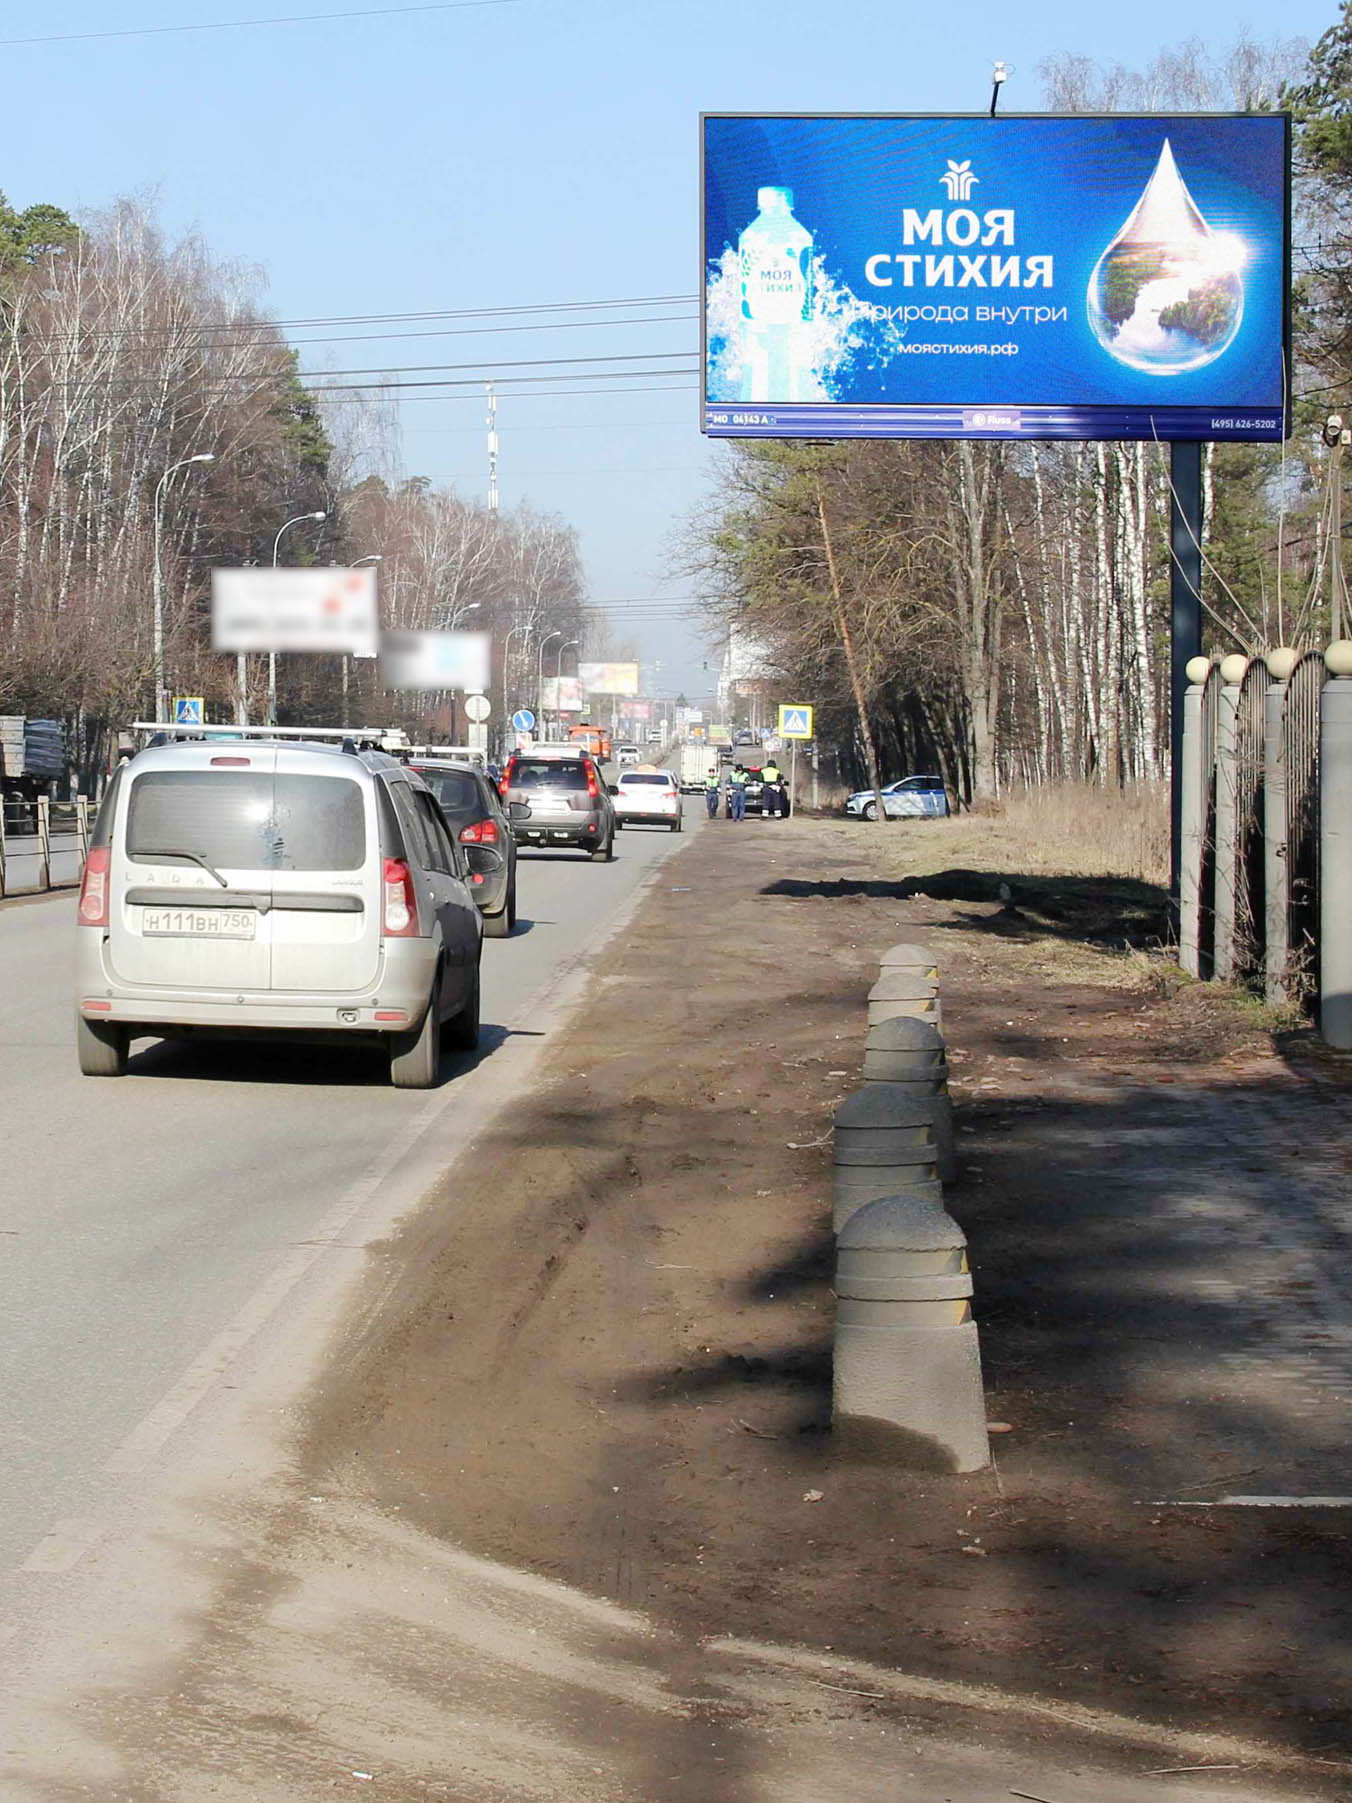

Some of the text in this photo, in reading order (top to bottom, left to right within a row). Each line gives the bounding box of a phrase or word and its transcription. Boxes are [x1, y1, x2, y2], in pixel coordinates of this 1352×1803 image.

[902, 209, 1015, 246] МОЯ
[760, 270, 792, 281] МОЯ
[865, 253, 1054, 288] СТИХИЯ
[975, 304, 1068, 325] внутри
[898, 341, 1019, 357] моястихия.рф
[1235, 418, 1277, 429] 626-5202
[125, 872, 205, 885] LADA
[222, 913, 250, 929] 750
